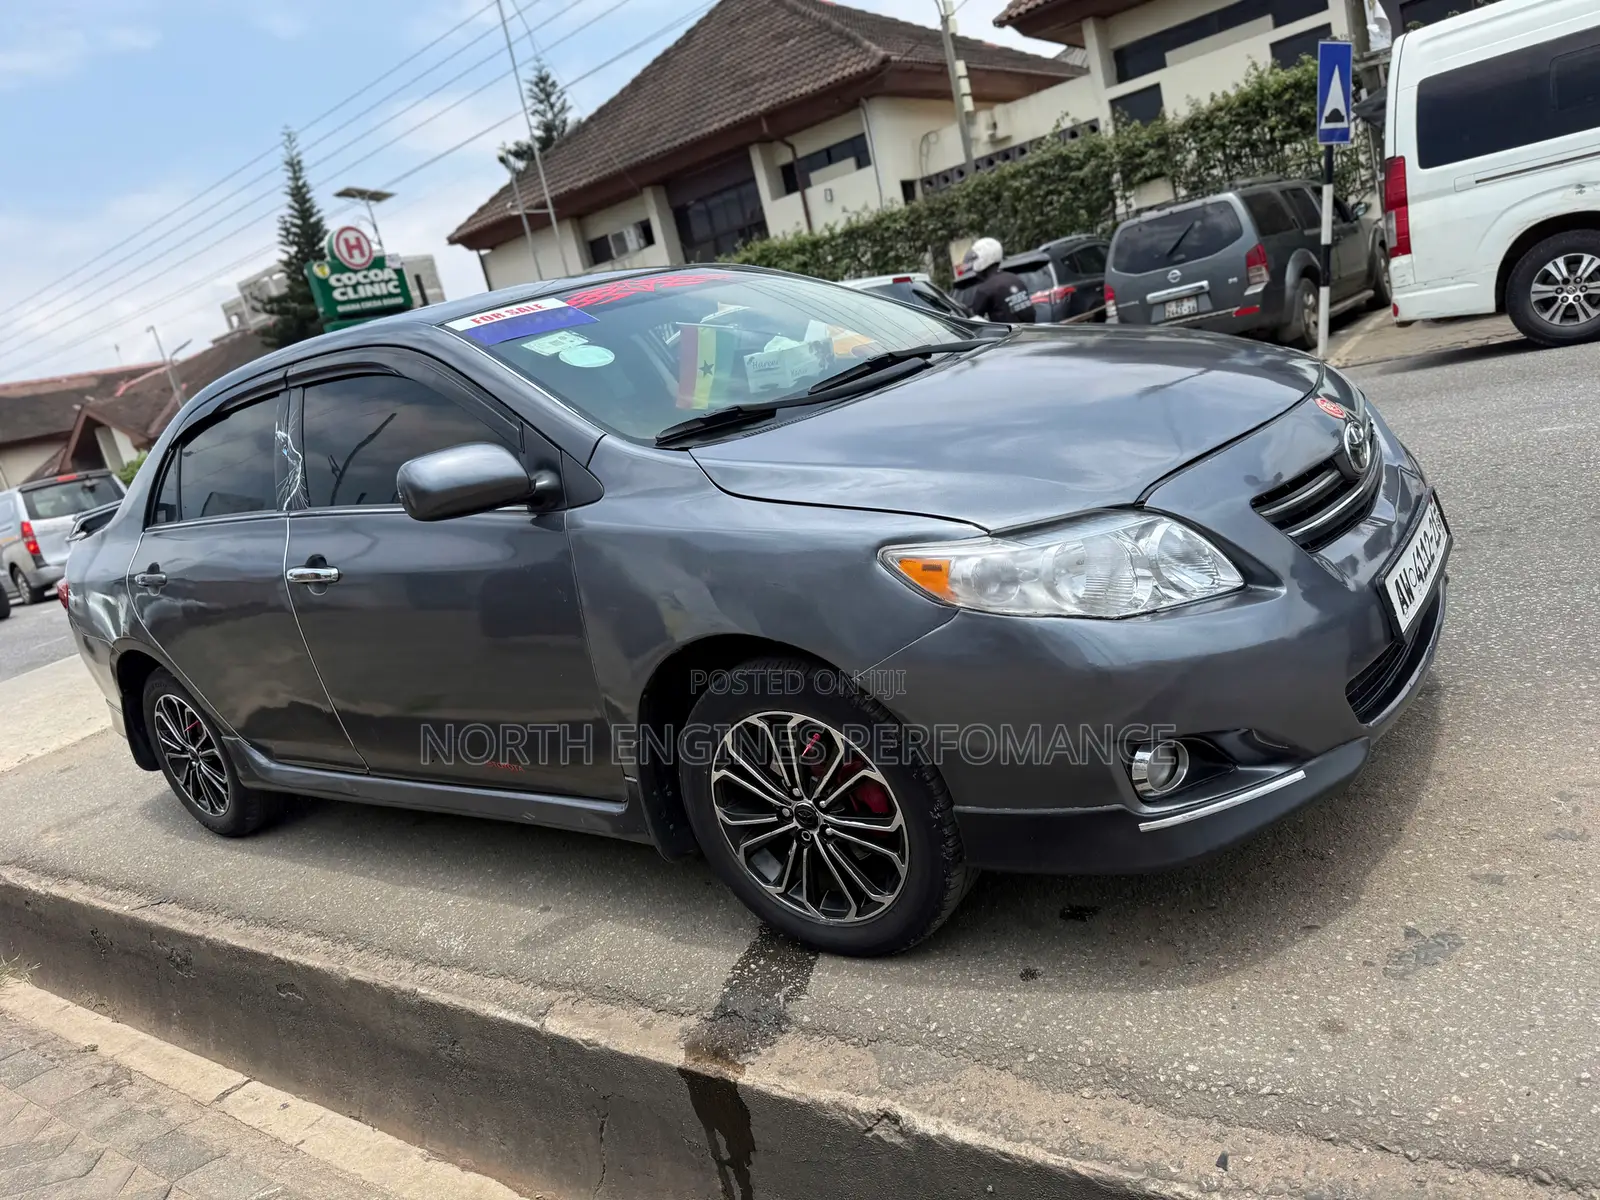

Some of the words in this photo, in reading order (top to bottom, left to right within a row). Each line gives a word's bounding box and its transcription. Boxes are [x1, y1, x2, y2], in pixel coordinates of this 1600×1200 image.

[343, 236, 366, 259] H
[328, 268, 398, 287] COCOA
[332, 280, 401, 301] CLINIC
[470, 312, 505, 325] FOR
[504, 304, 545, 316] SALE
